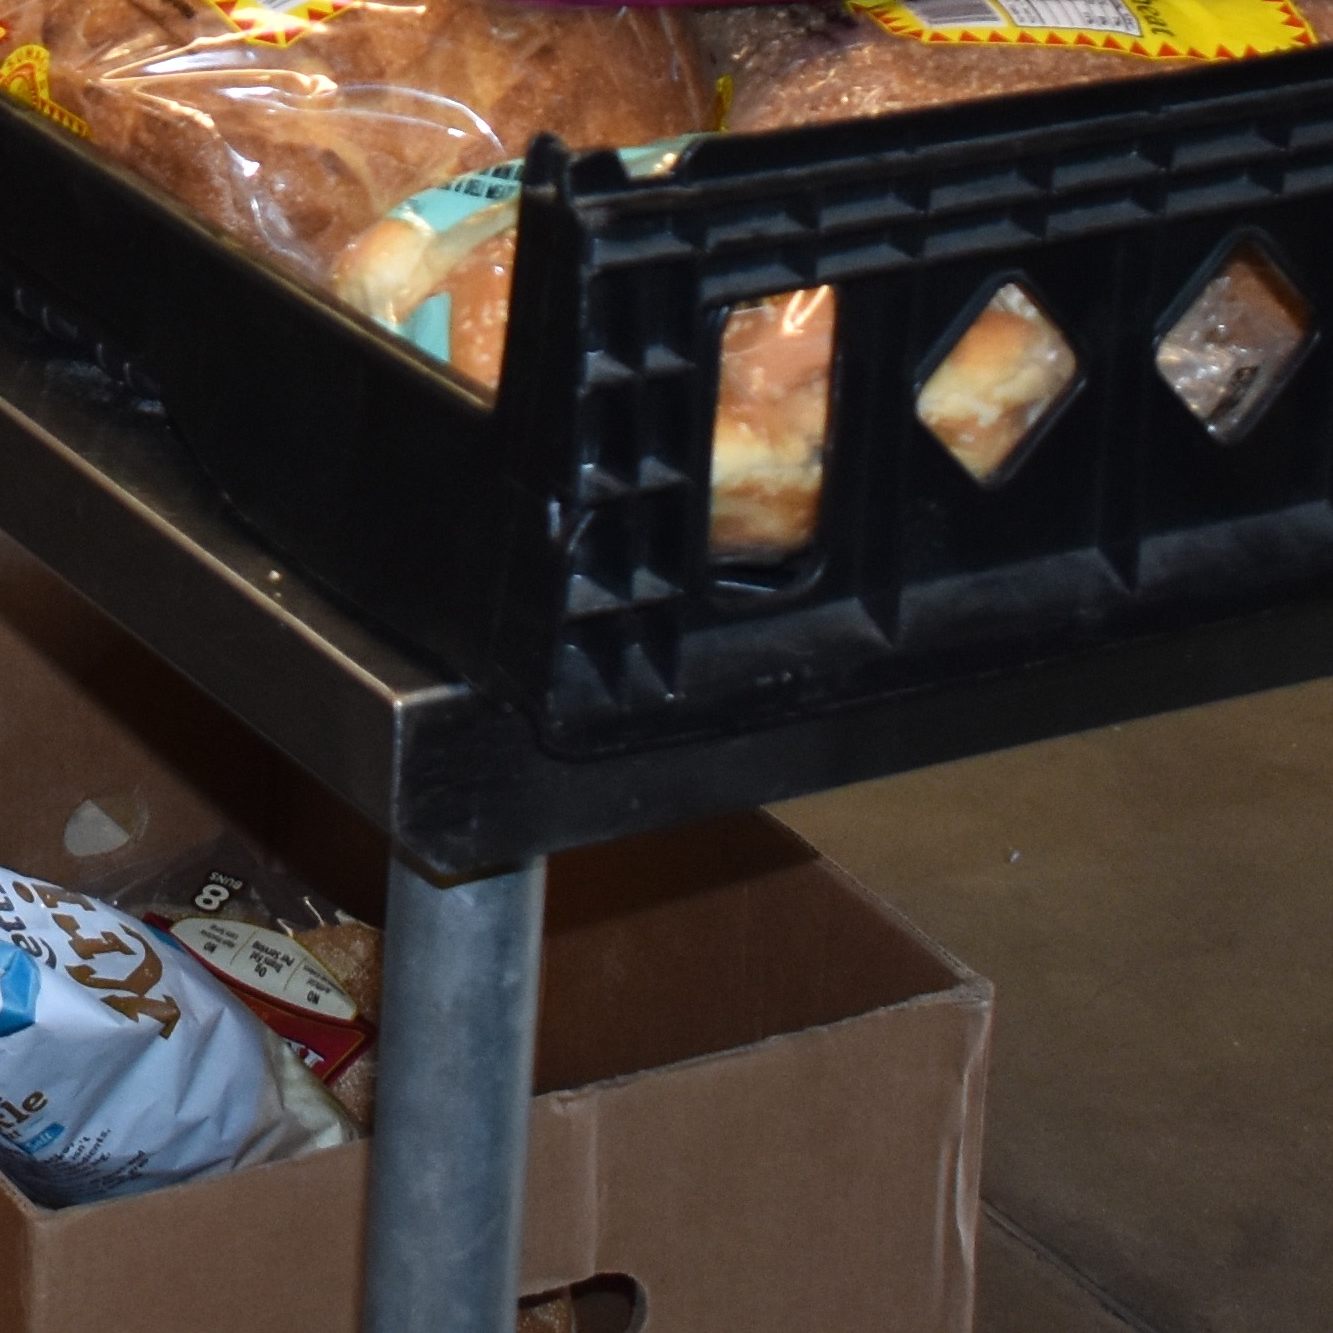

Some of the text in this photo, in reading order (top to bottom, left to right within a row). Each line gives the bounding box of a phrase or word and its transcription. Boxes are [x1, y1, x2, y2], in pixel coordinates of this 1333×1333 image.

[208, 870, 244, 890] BUNS
[194, 883, 230, 911] 8
[249, 952, 284, 974] Trans Fat
[252, 940, 296, 968] Per Serving
[254, 963, 268, 978] 0g
